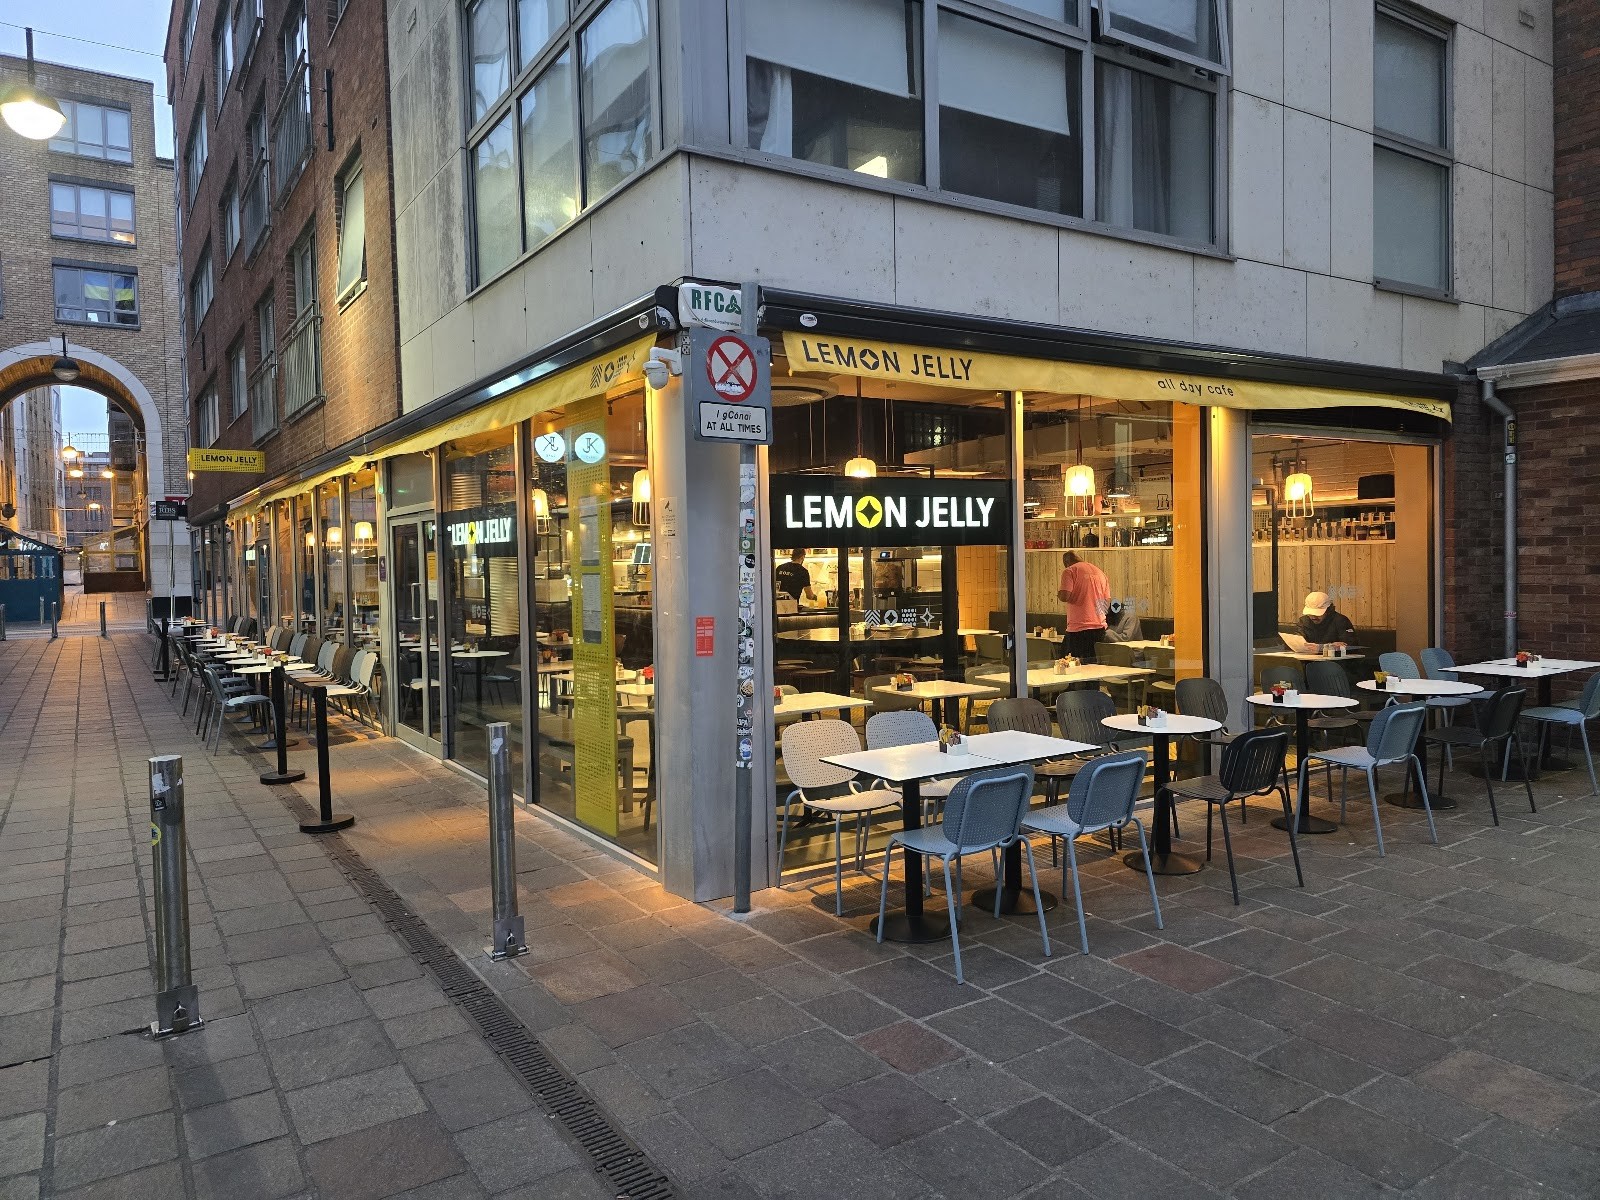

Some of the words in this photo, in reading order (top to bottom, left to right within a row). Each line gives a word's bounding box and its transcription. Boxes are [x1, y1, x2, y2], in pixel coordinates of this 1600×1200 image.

[691, 288, 725, 313] RFC
[801, 340, 901, 374] LEMON
[910, 353, 973, 381] JELLY
[1157, 378, 1175, 390] all
[1179, 380, 1202, 396] day
[1207, 384, 1234, 397] cafe
[706, 421, 717, 431] AT
[720, 422, 735, 432] ALL
[737, 423, 762, 434] TIMES
[201, 454, 233, 463] LEMON
[235, 455, 258, 464] JELLY
[785, 494, 907, 529] LEMON
[915, 495, 995, 528] JELLY
[451, 520, 484, 546] LEMON
[484, 517, 512, 544] JELLY
